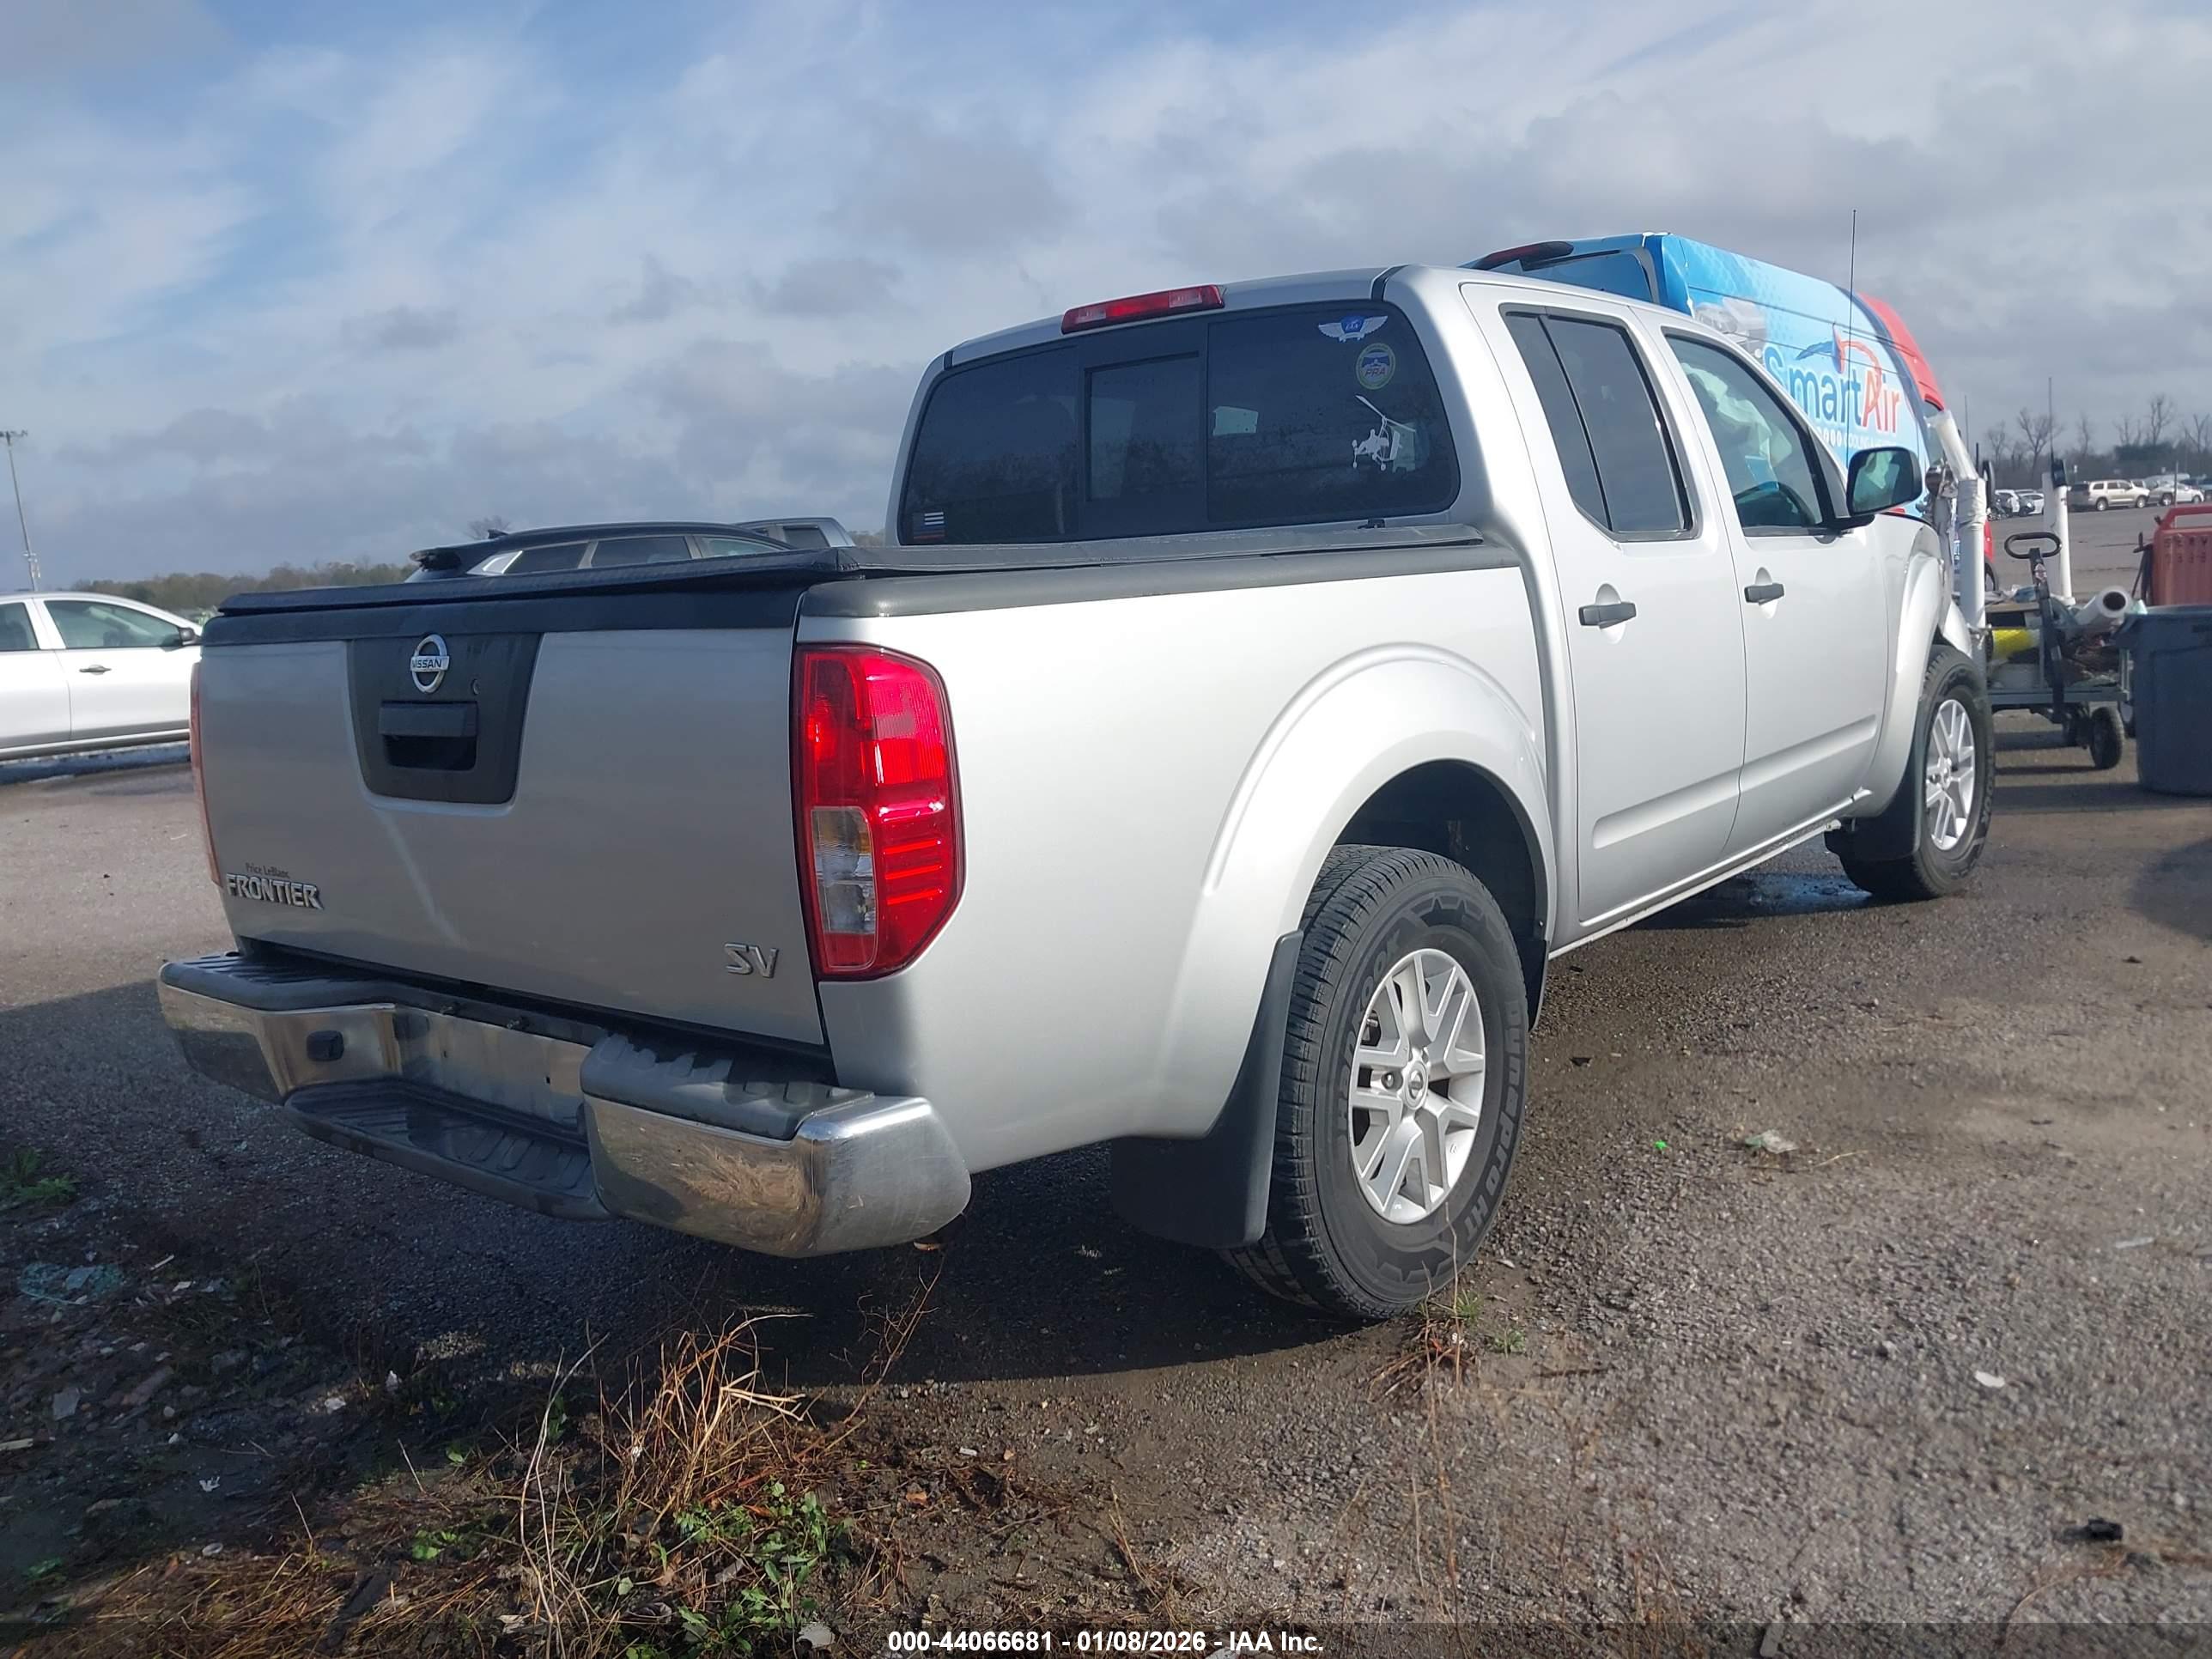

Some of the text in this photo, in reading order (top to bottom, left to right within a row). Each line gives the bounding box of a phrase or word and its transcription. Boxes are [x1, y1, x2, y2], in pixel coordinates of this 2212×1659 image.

[412, 659, 442, 668] NISSAN
[226, 872, 325, 910] FRONTIER
[724, 942, 780, 979] SV
